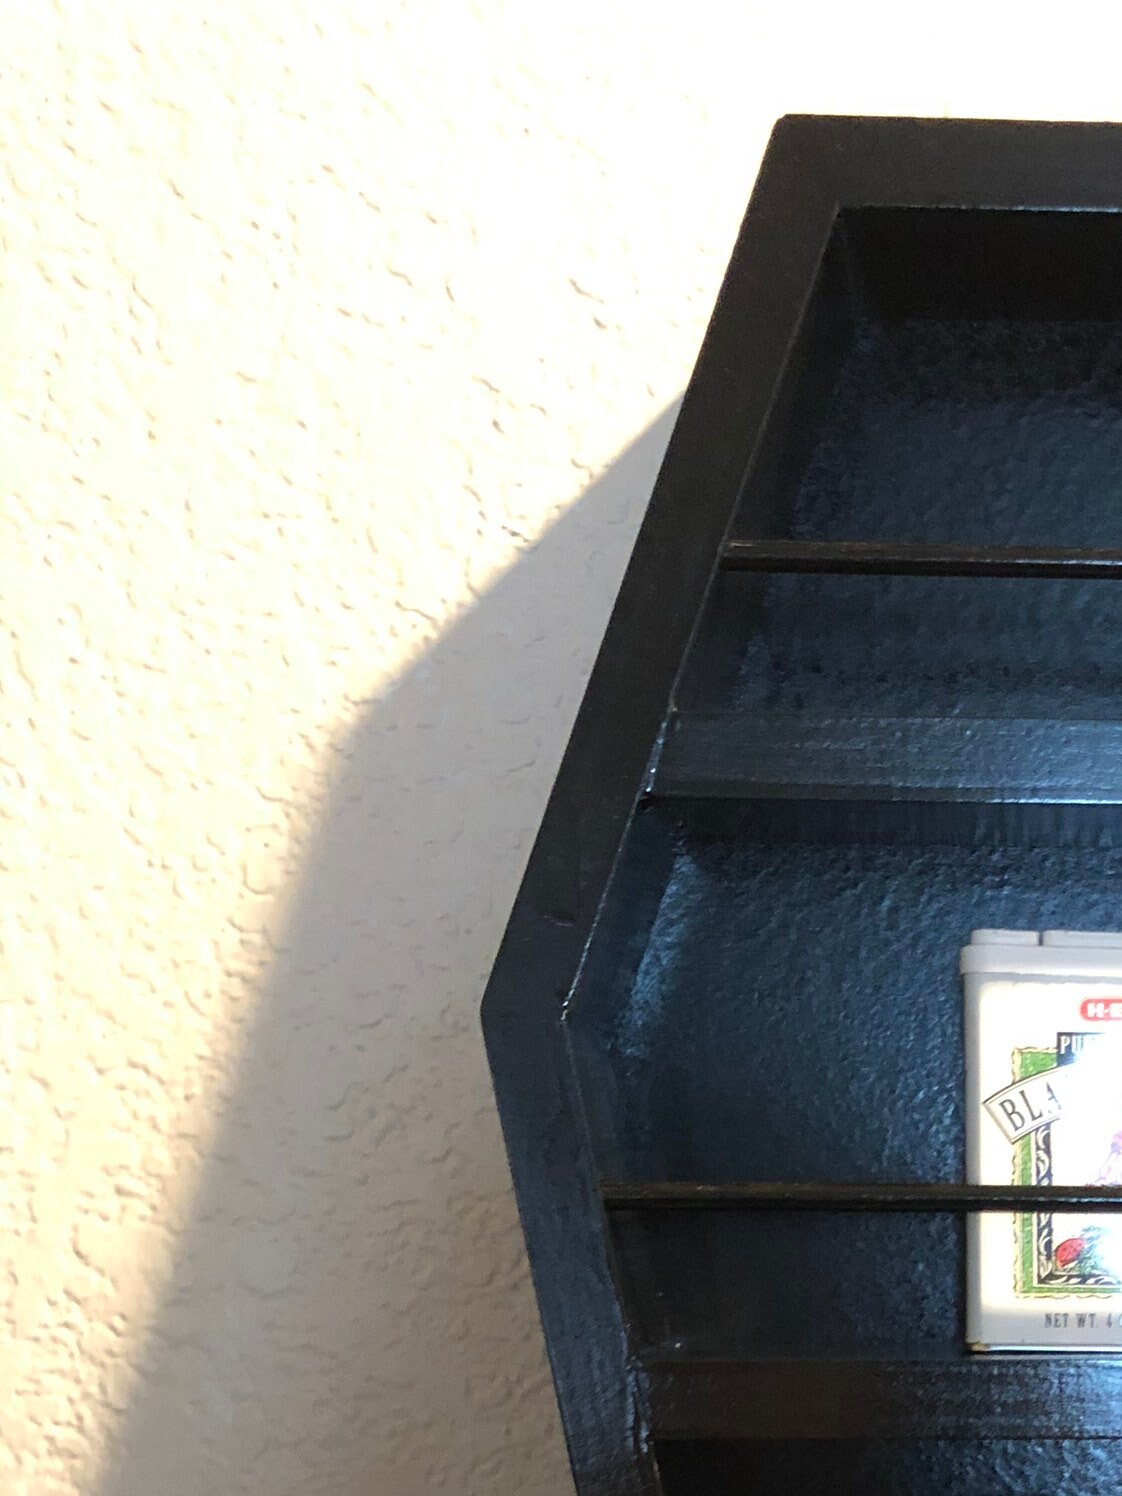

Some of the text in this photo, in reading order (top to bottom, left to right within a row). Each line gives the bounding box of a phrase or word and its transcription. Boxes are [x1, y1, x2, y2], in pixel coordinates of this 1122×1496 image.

[998, 1081, 1062, 1132] BLA
[1044, 1313, 1068, 1328] NET
[1105, 1313, 1113, 1328] 4
